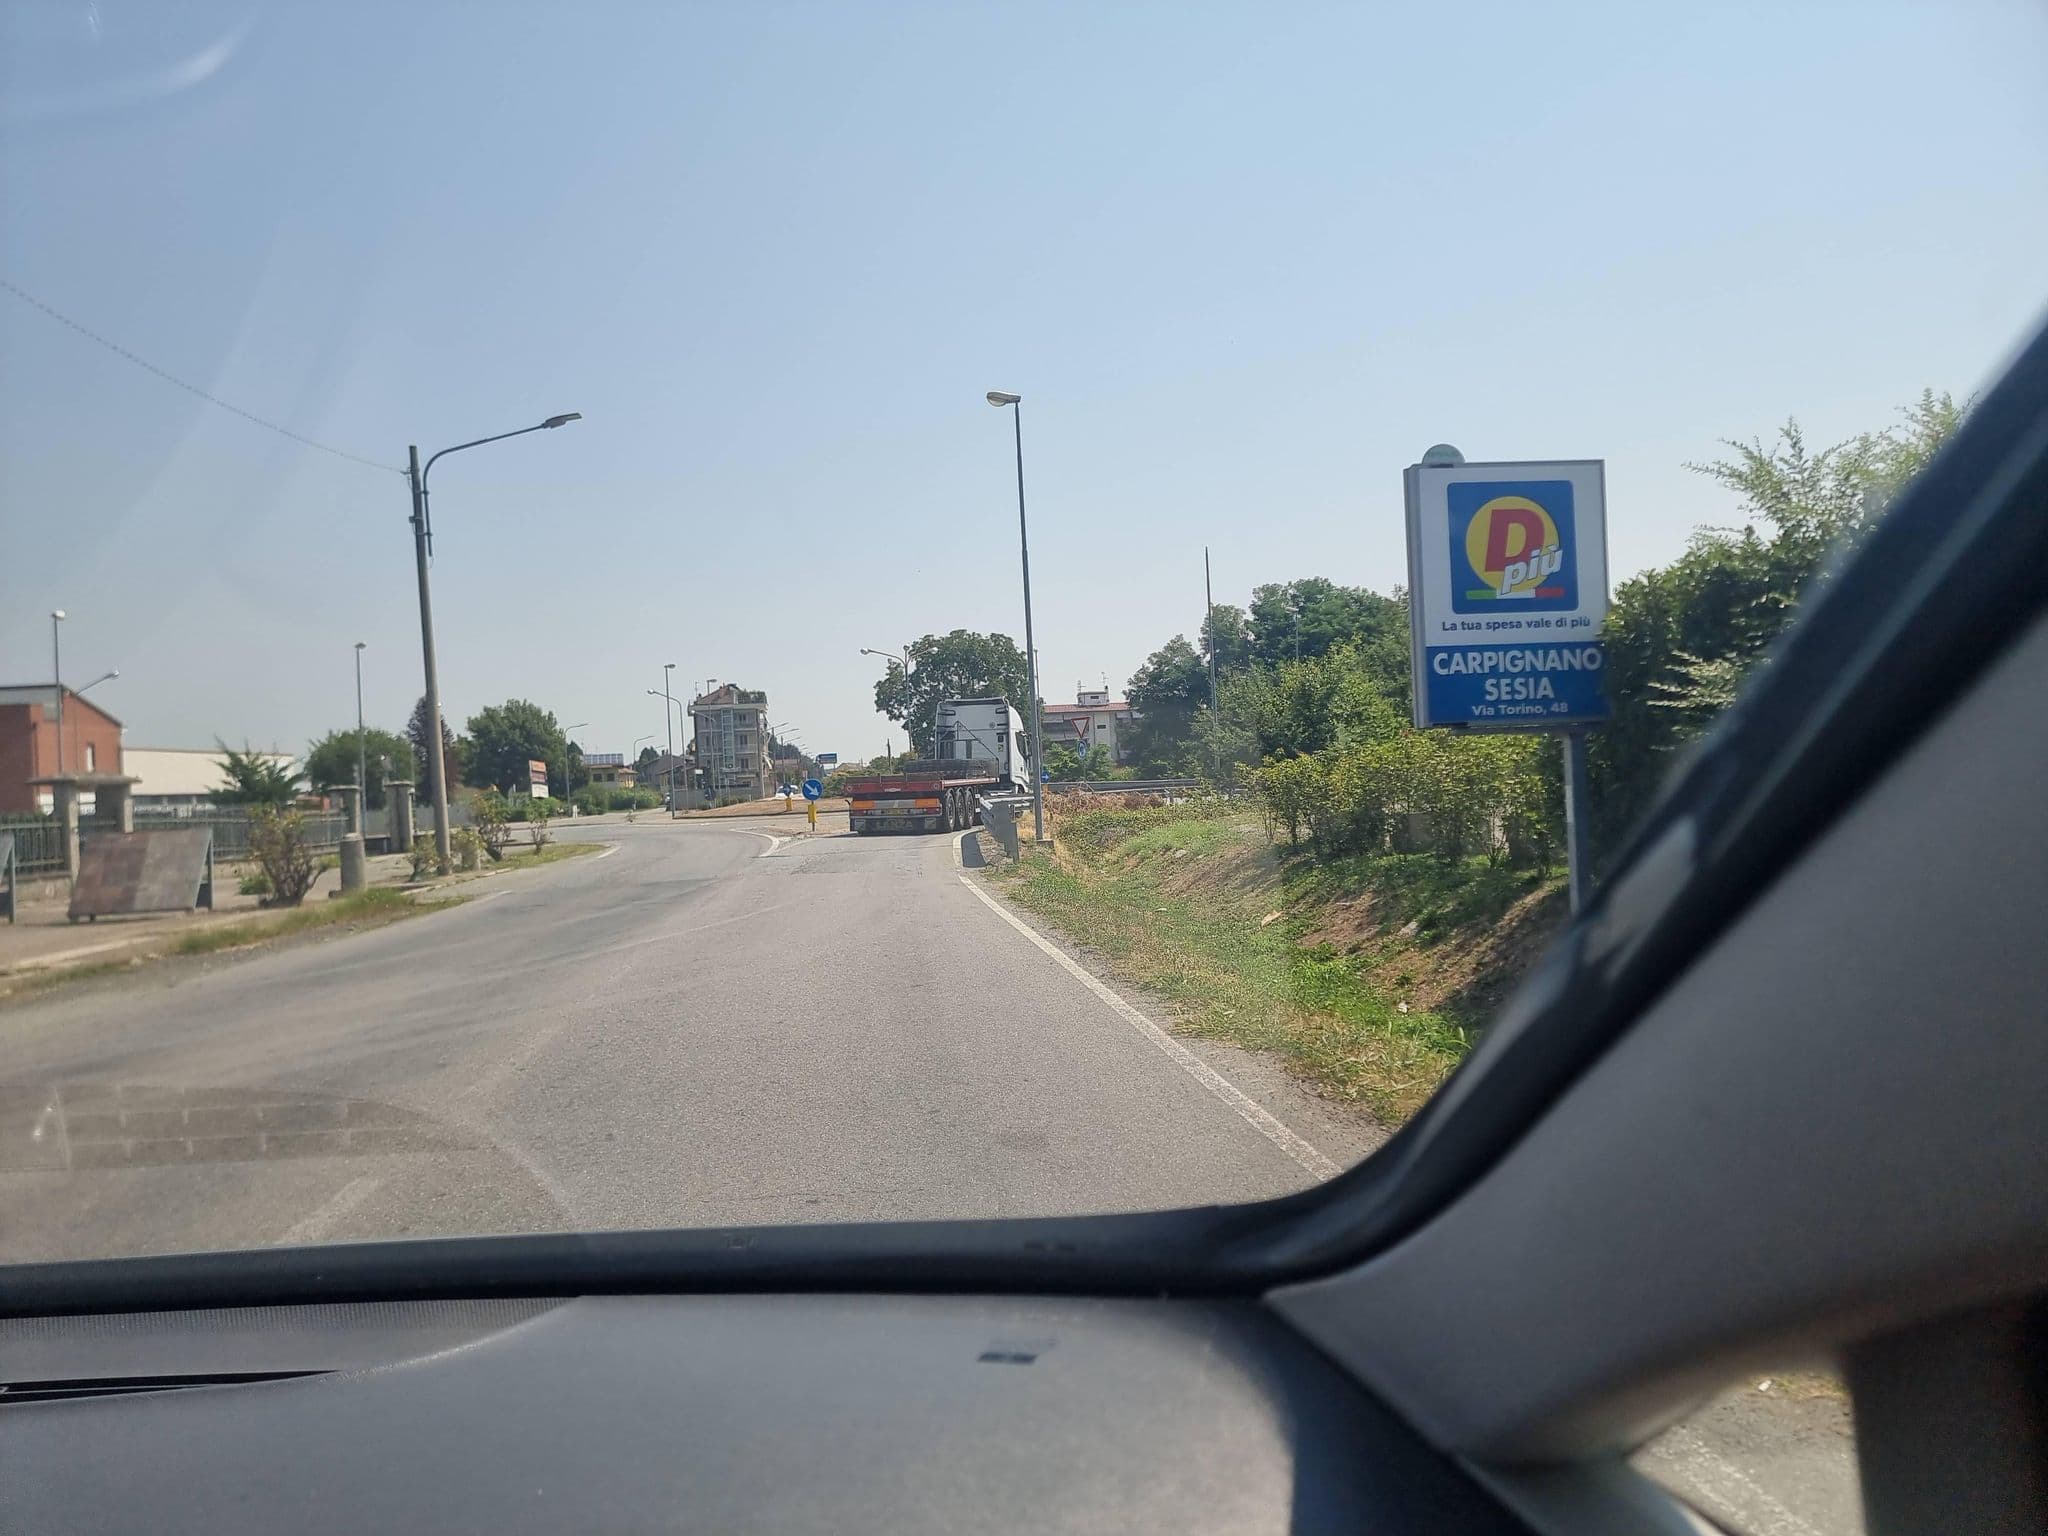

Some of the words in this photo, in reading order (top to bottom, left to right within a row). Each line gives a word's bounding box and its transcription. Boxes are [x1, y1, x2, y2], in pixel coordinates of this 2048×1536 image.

[1485, 508, 1545, 572] D
[1441, 621, 1458, 631] La
[1461, 620, 1482, 631] tua
[1485, 619, 1523, 632] spesa
[1526, 617, 1552, 629] vale
[1555, 616, 1567, 628] di
[1570, 616, 1591, 629] più
[1433, 647, 1602, 675] CARPIGNANO
[1484, 677, 1555, 701] SESIA
[1471, 704, 1495, 716] Via
[1498, 703, 1547, 715] Torino,
[1550, 702, 1568, 713] 48
